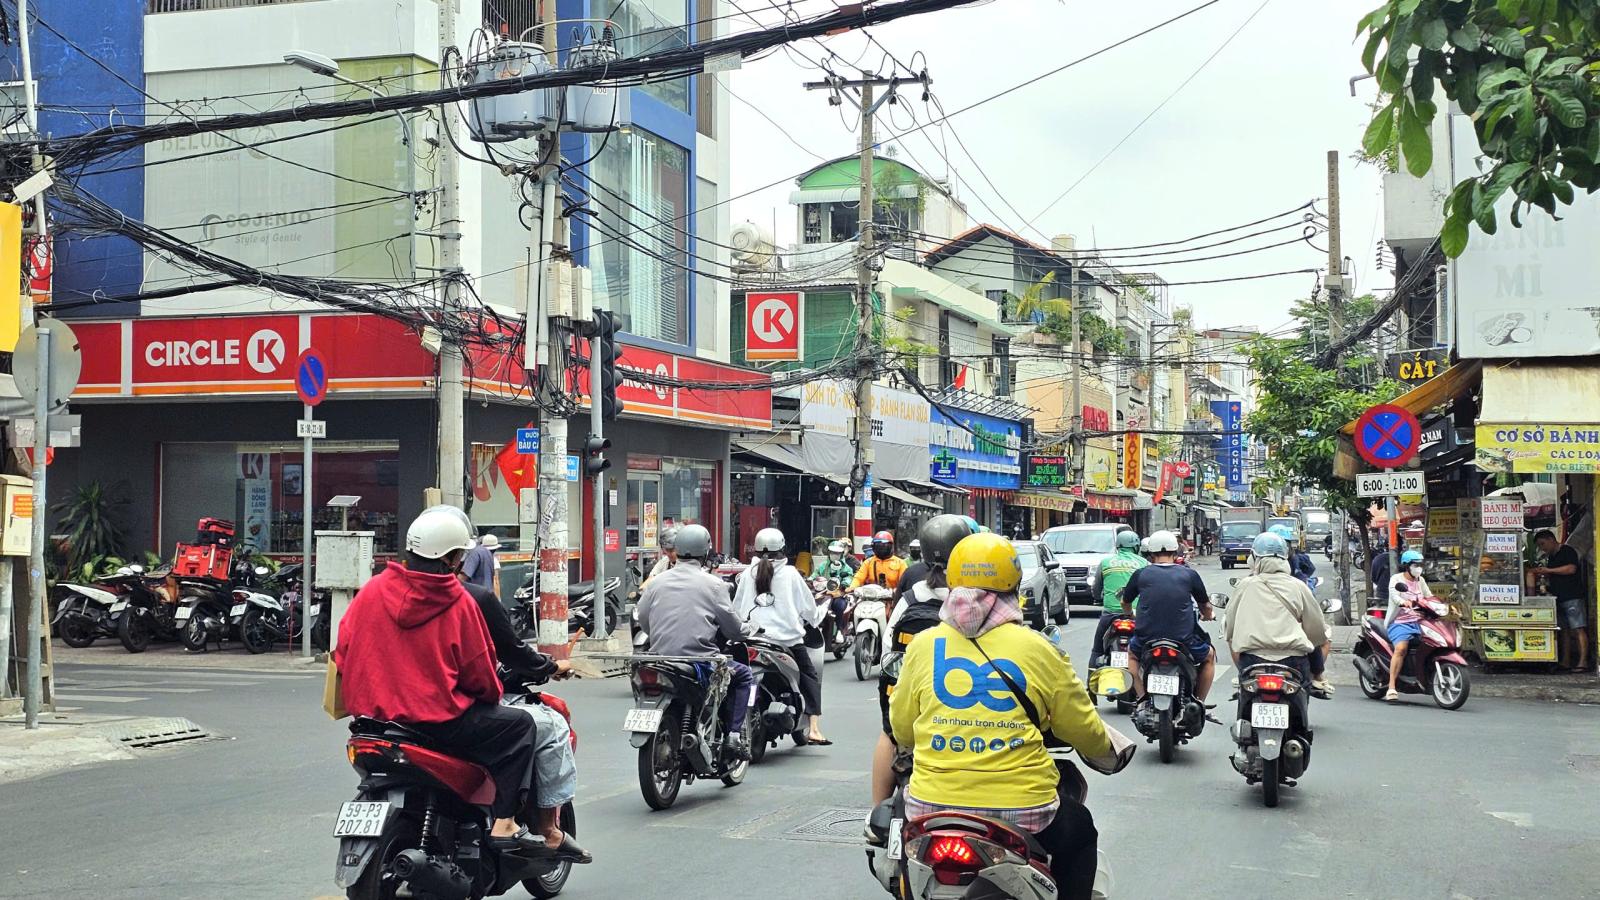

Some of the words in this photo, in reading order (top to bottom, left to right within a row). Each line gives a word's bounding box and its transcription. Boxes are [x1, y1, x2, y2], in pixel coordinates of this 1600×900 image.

[758, 304, 792, 340] K
[145, 339, 240, 367] CIRCLE
[253, 334, 282, 371] K
[1399, 351, 1437, 380] CẮT
[870, 418, 883, 437] FFEE
[1495, 427, 1519, 443] CƠ
[1522, 422, 1545, 443] SỞ
[1549, 427, 1599, 444] BÁNH
[518, 438, 532, 450] BÀU
[1550, 447, 1575, 459] CÁC
[1363, 479, 1383, 491] 6:00
[1392, 477, 1418, 490] 21:00
[1483, 501, 1508, 513] BÁNH
[1510, 501, 1521, 513] MÌ
[1483, 516, 1499, 525] HEO
[1502, 515, 1522, 527] QUAY
[932, 637, 1027, 713] be
[1258, 705, 1283, 717] 85-C1
[949, 716, 973, 727] nhau
[975, 718, 995, 729] trọn
[1254, 716, 1286, 728] 413.86
[345, 803, 383, 818] 59-P3
[336, 818, 380, 835] 207.81
